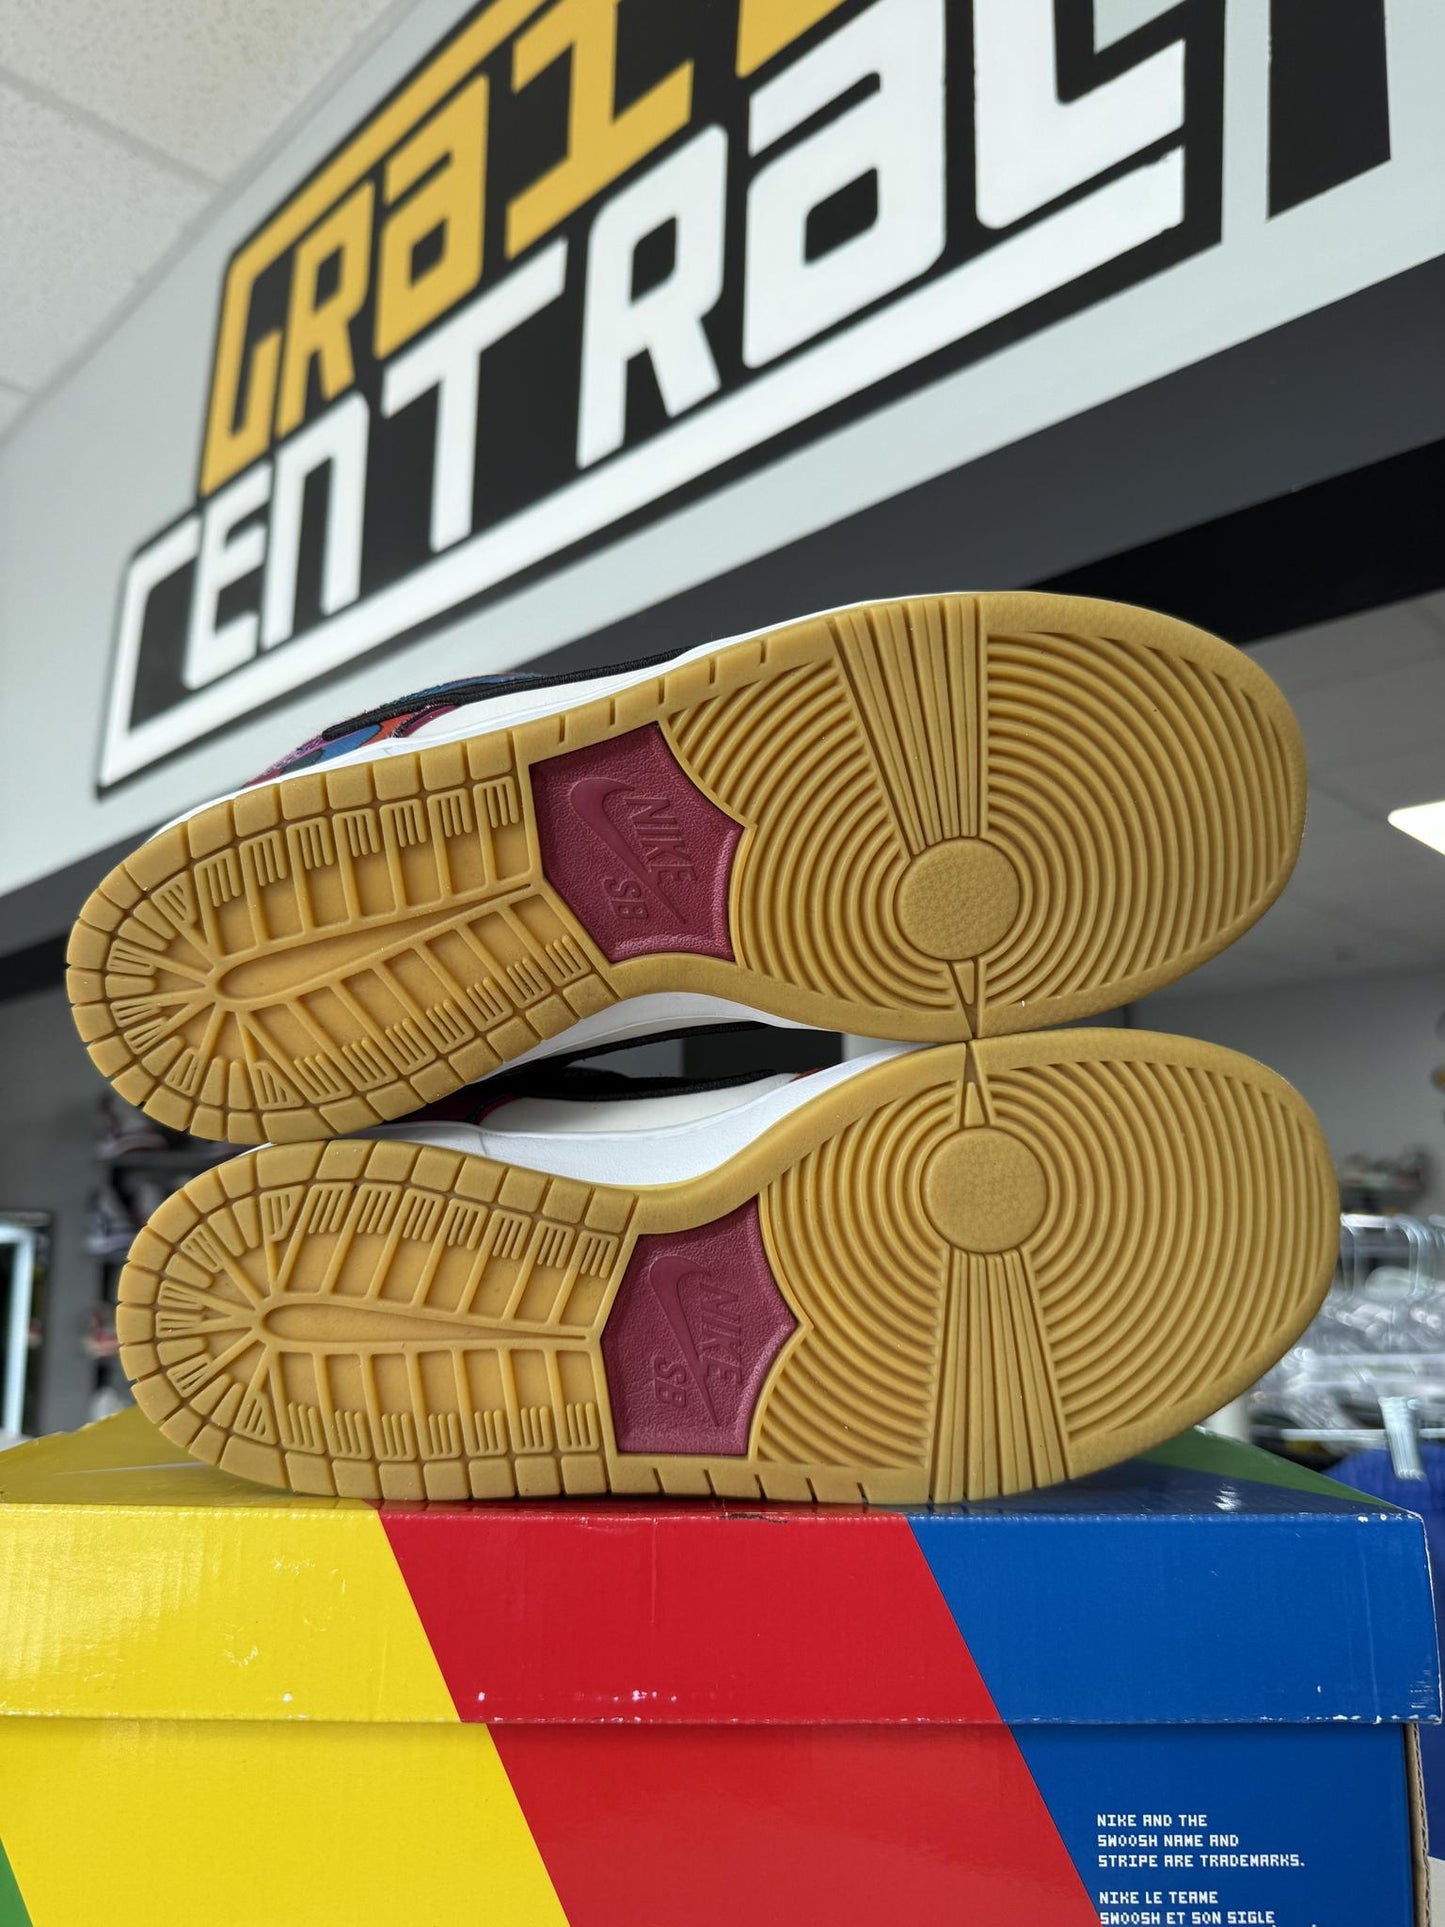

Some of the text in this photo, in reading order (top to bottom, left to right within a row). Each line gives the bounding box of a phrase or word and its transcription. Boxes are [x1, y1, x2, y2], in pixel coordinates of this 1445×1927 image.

[622, 796, 698, 885] NIKE
[602, 876, 649, 920] SB
[699, 1281, 743, 1386] NIKE
[653, 1354, 688, 1409] SB
[1097, 1814, 1208, 1827] NIKE AND THE
[1097, 1834, 1239, 1847] SWOOSH NAME AND
[1098, 1853, 1305, 1867] STRIPE ARE TRADEMARKS.
[1099, 1891, 1140, 1904] NIKE
[1145, 1891, 1163, 1904] LE
[1099, 1910, 1275, 1925] SWOOSH ET SON SIGLE
